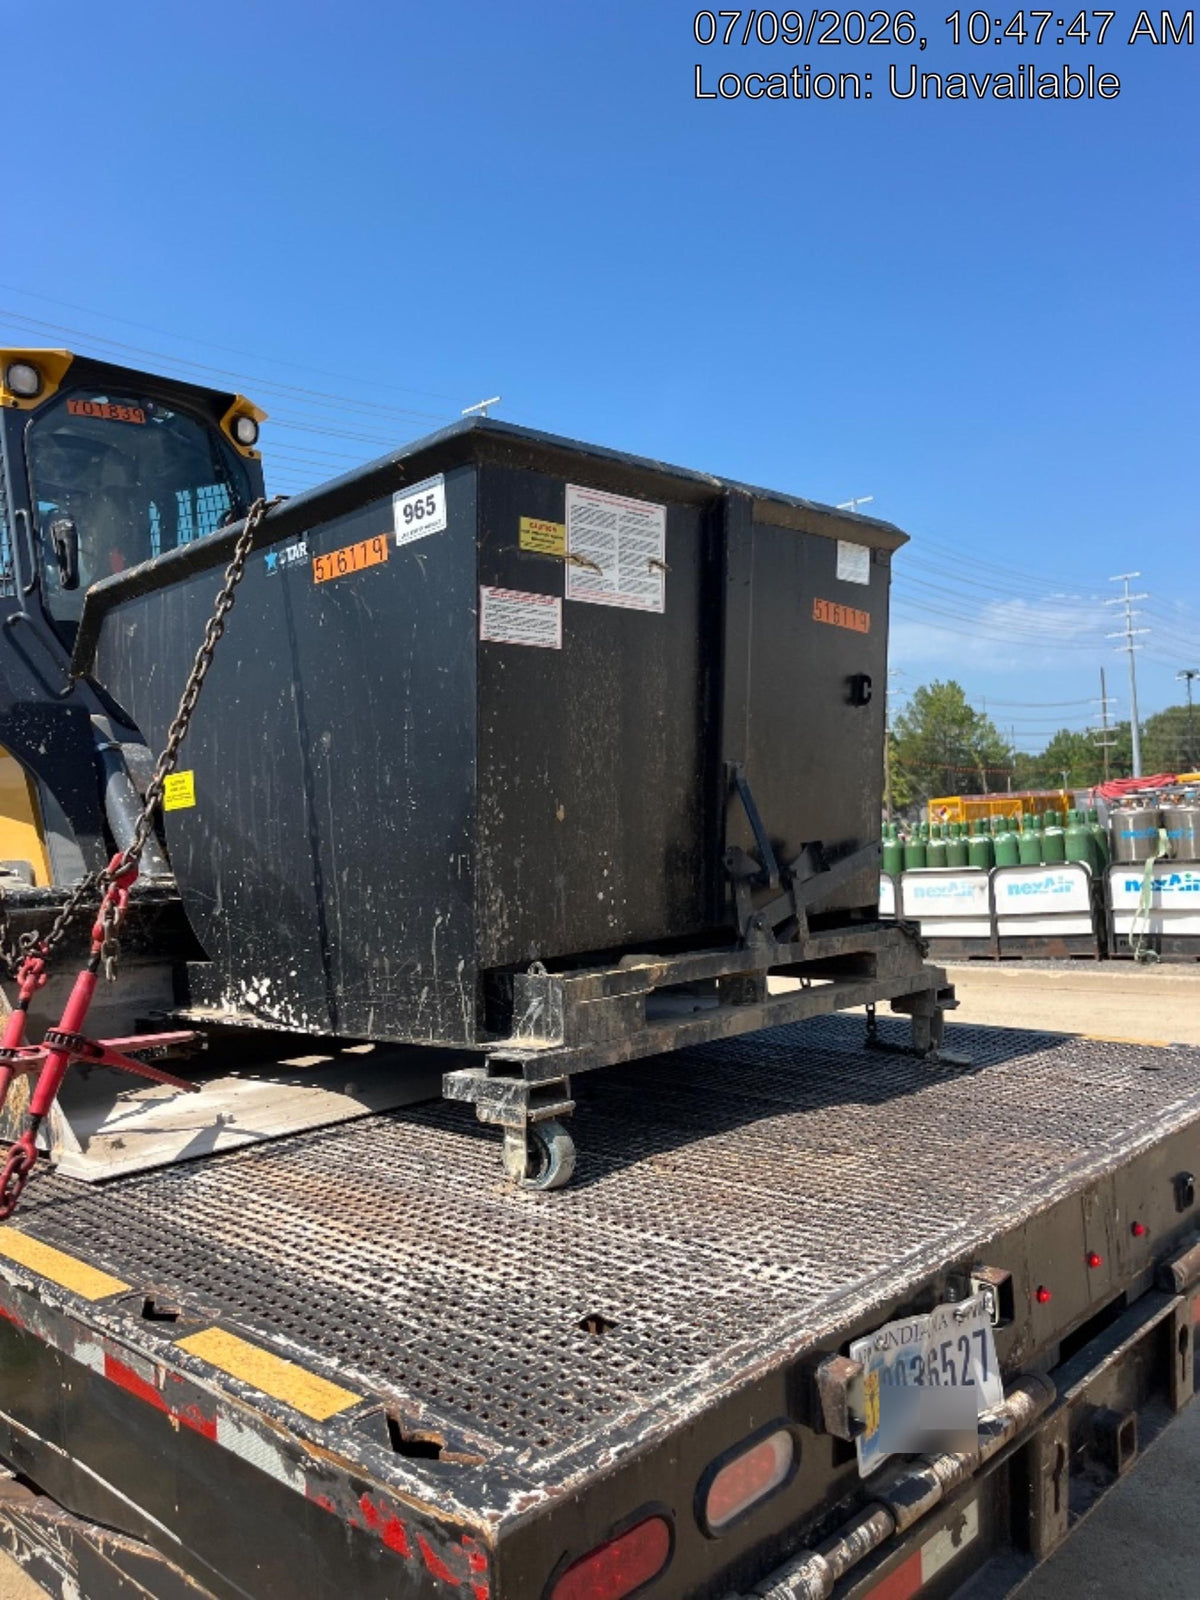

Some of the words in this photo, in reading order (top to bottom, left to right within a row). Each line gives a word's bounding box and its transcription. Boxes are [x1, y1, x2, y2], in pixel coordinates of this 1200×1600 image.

[403, 493, 437, 525] 965
[315, 537, 384, 581] 516119
[814, 600, 867, 630] 516119
[1007, 876, 1075, 896] nexAir
[1125, 872, 1200, 892] nxAir
